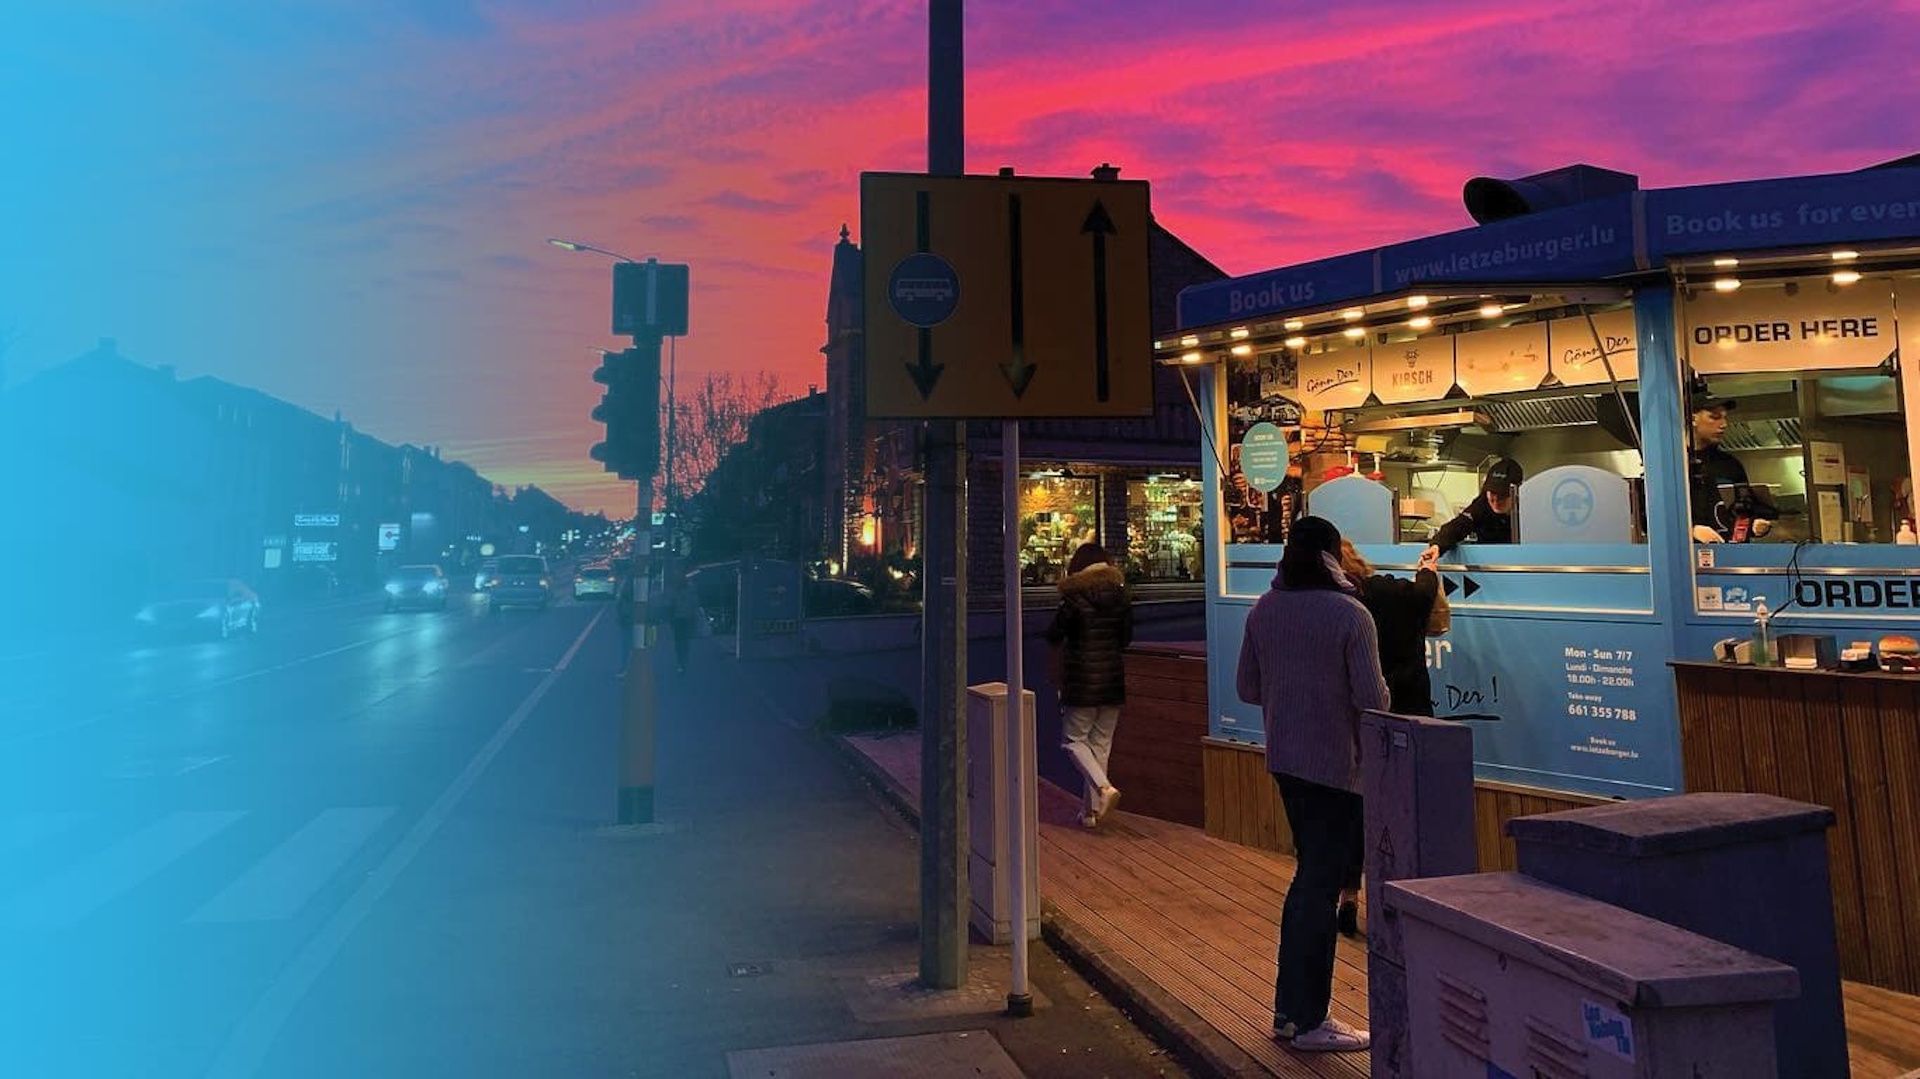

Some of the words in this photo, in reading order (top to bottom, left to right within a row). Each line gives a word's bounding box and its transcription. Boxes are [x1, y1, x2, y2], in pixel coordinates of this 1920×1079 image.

[1666, 210, 1743, 236] Book
[1751, 210, 1783, 229] us
[1796, 202, 1844, 226] for
[1229, 282, 1284, 314] Book
[1290, 280, 1315, 306] us
[1394, 226, 1614, 283] www.letzeburger.lu
[1695, 323, 1790, 344] ORDER
[1801, 318, 1878, 339] HERE
[1605, 337, 1631, 351] Der
[1392, 370, 1433, 388] KIRSCH
[1565, 647, 1586, 658] Mon
[1593, 649, 1613, 660] Sun
[1616, 651, 1633, 660] 7/7
[1565, 662, 1587, 671] Lundi
[1593, 664, 1633, 674] Dimanche
[1567, 674, 1596, 685] 18.00h
[1446, 684, 1485, 711] Der
[1568, 704, 1588, 716] 661
[1591, 706, 1612, 718] 355
[1615, 708, 1637, 721] 788
